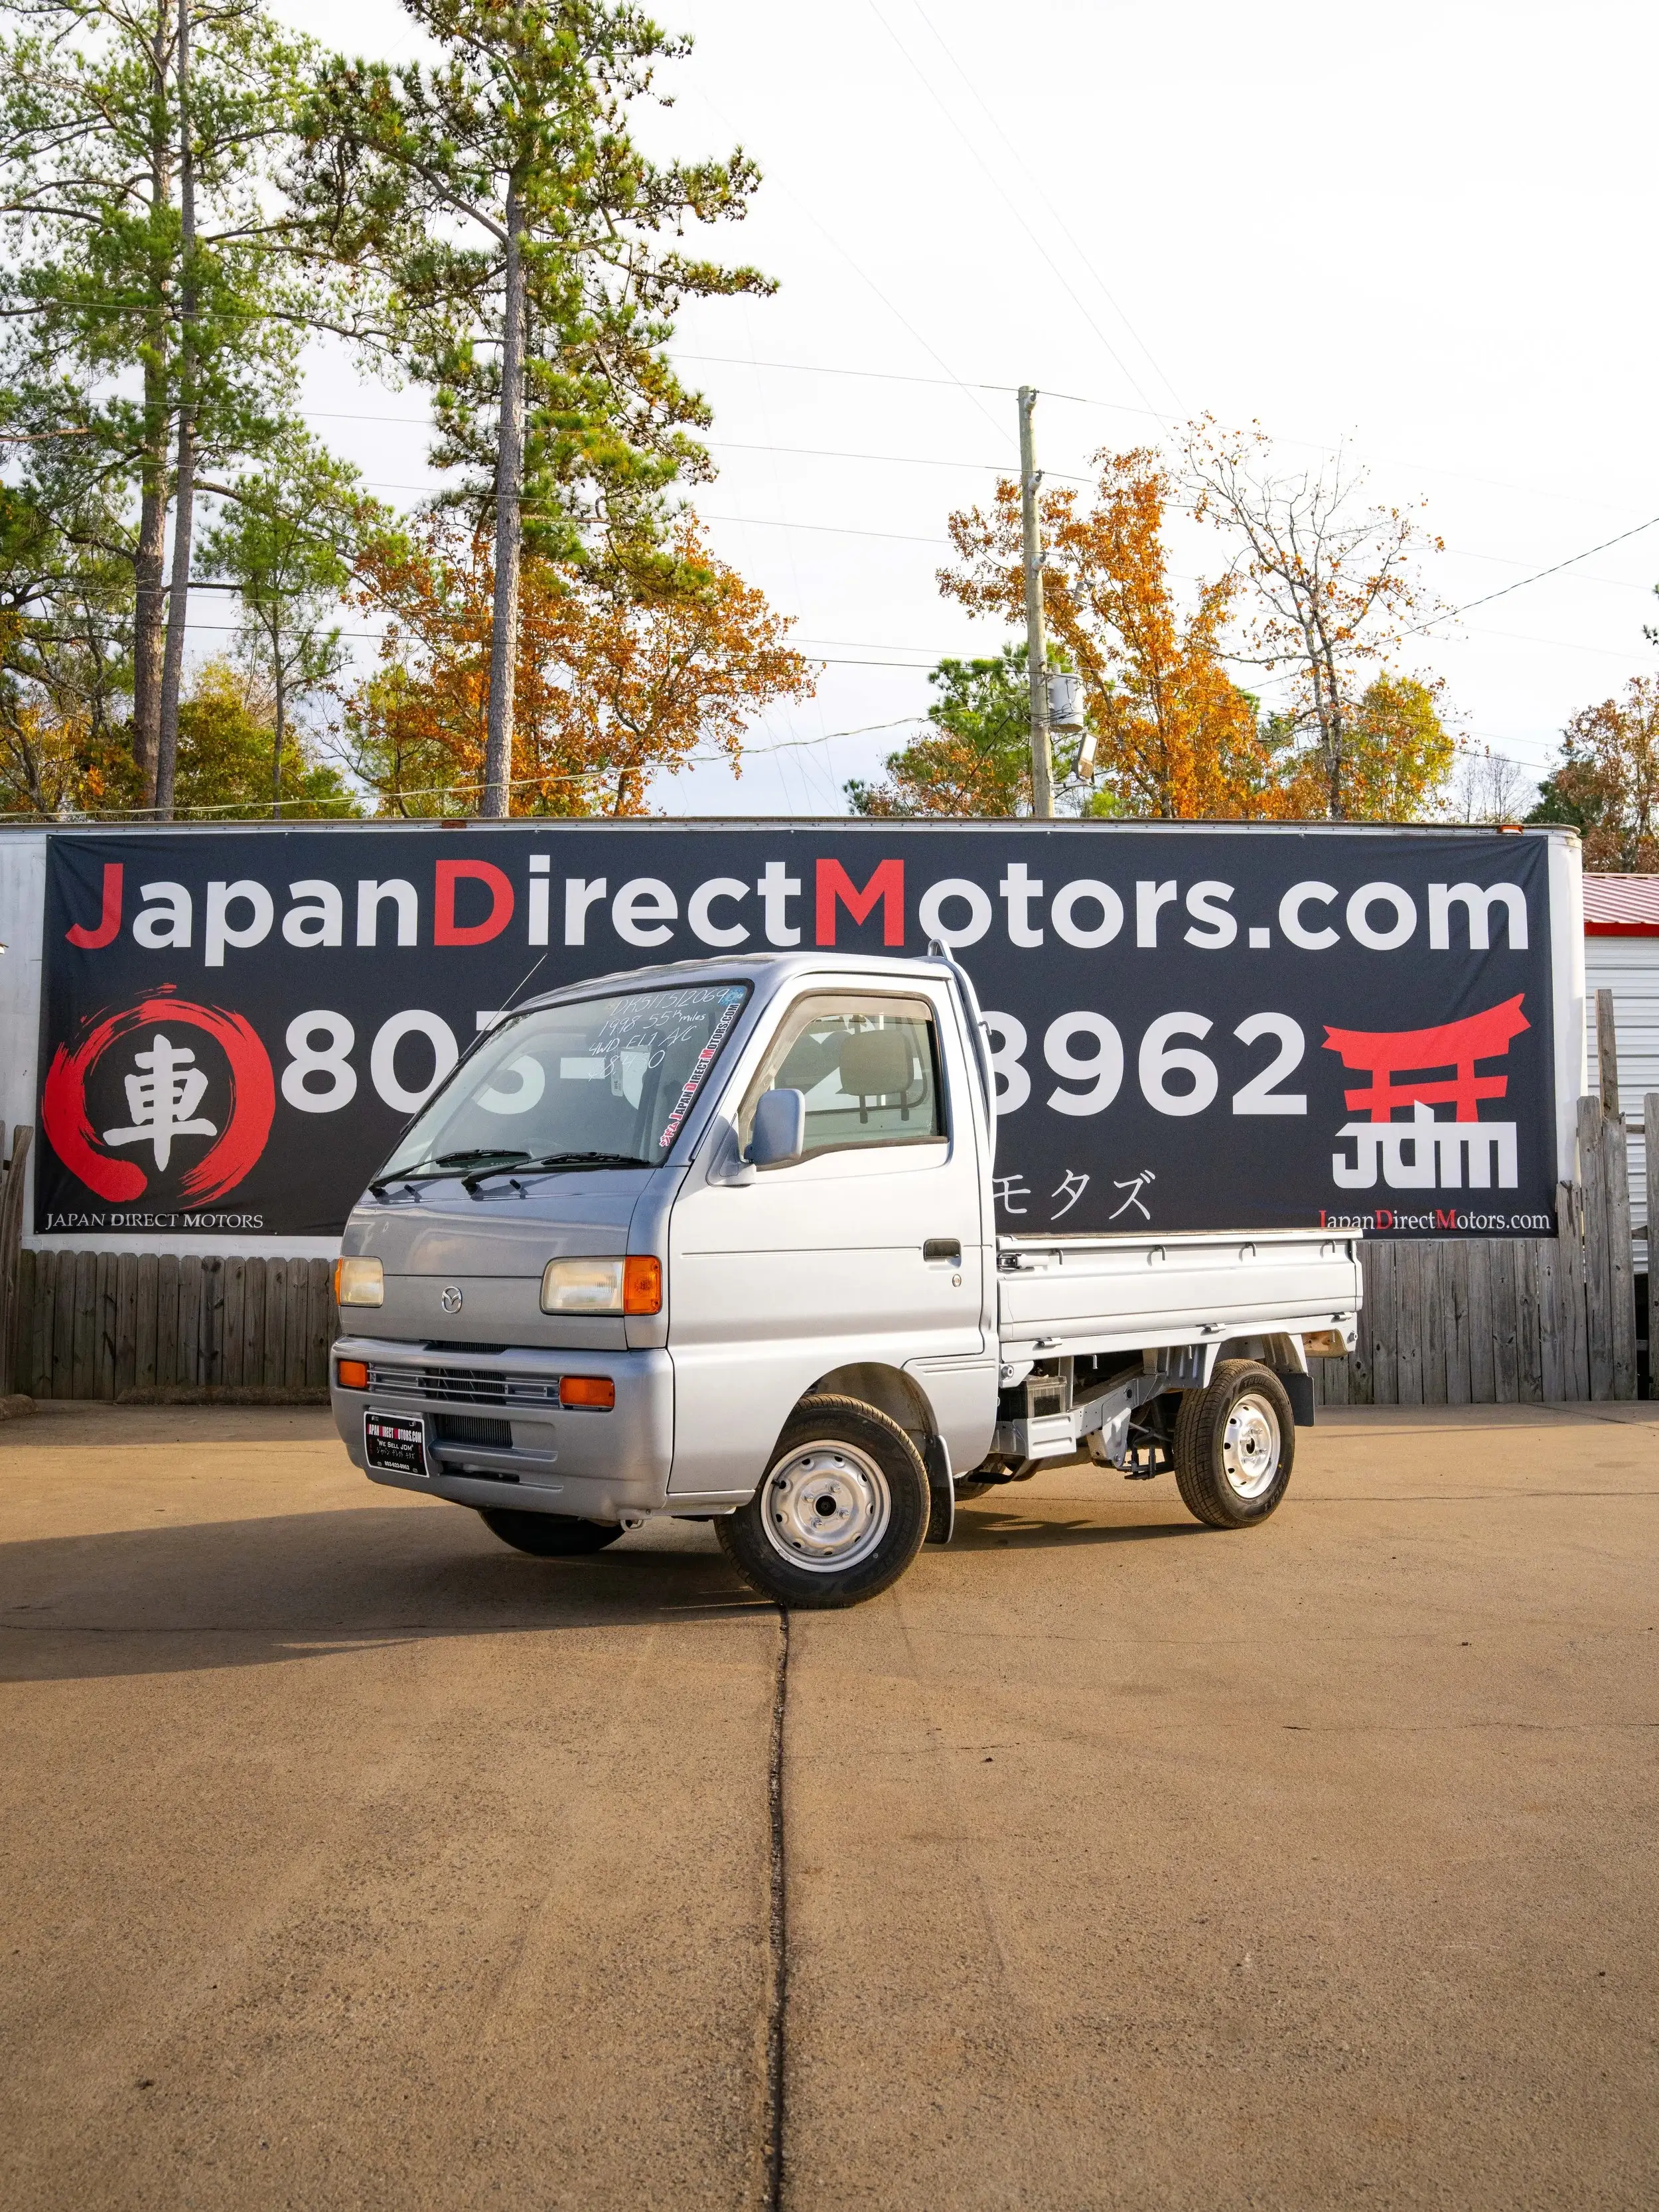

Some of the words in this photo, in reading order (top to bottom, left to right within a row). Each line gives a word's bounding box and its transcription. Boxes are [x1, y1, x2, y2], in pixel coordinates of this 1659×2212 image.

[65, 855, 1528, 966] JapanDirectMotors.com
[599, 1015, 642, 1037] 1998
[679, 1011, 707, 1023] miles
[589, 1037, 620, 1056] 4WD
[102, 1034, 218, 1172] 車
[45, 1213, 106, 1230] JAPAN
[110, 1213, 179, 1226] DIRECT
[182, 1214, 263, 1228] MOTORS
[1318, 1209, 1551, 1230] JapanDirectMotors.com
